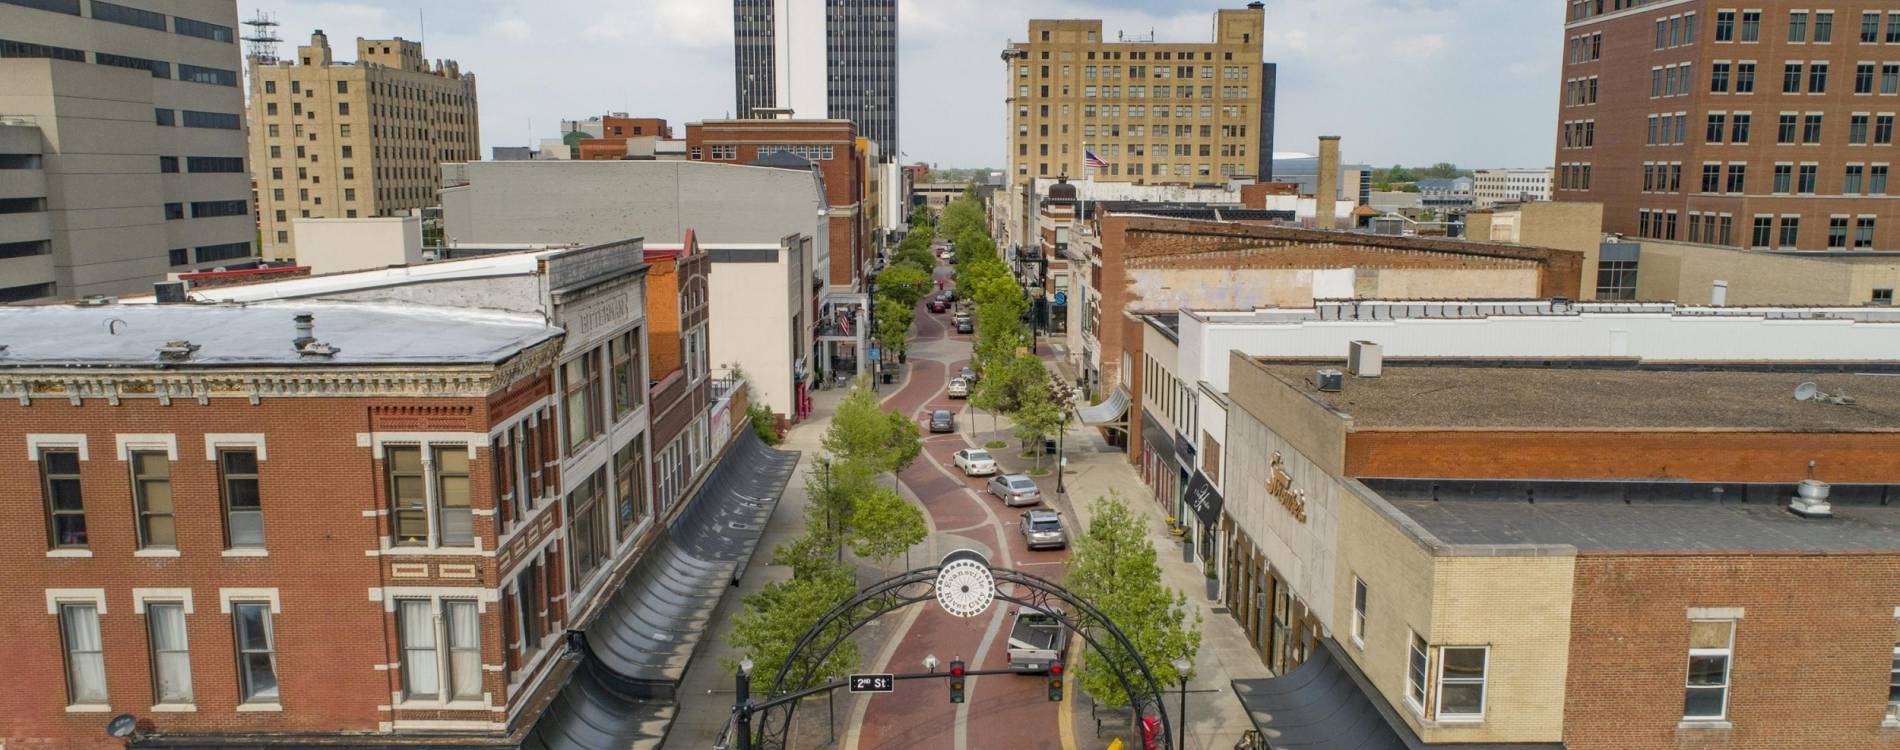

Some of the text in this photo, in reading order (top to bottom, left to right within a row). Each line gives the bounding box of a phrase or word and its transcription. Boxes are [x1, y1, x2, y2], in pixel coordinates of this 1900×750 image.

[944, 569, 985, 589] Evansville
[944, 591, 986, 610] River City
[874, 678, 887, 689] St
